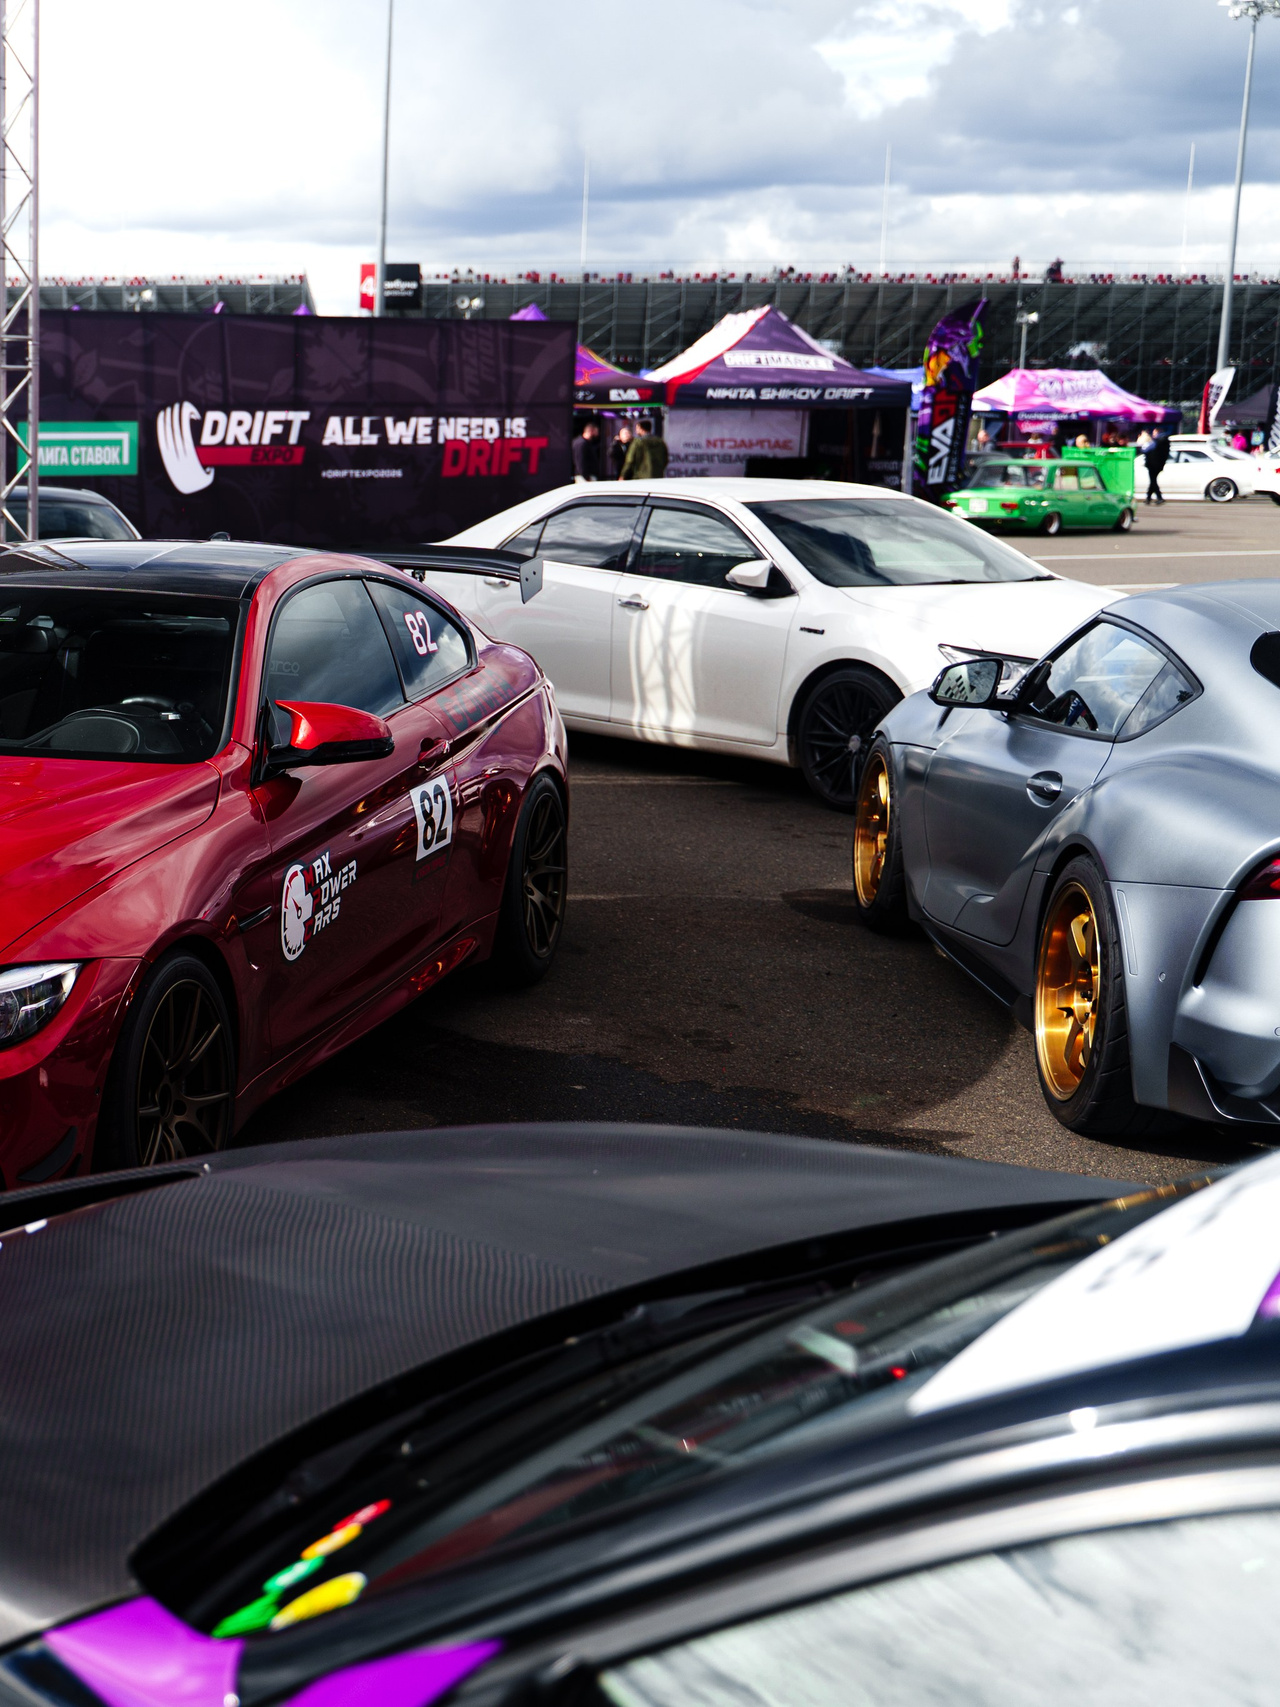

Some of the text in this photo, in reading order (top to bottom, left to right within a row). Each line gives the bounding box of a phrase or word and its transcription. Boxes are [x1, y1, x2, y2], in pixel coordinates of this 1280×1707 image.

[706, 387, 874, 400] NIKITA SHIKOV DRIFT
[200, 411, 310, 445] DRIFT
[322, 416, 528, 446] ALL WE NEED IS
[71, 446, 121, 466] СТАВОК
[250, 446, 295, 463] EXPO
[441, 437, 549, 477] DRIFT
[404, 611, 438, 656] 82
[420, 784, 449, 850] 82
[303, 851, 332, 892] MAX
[312, 860, 357, 913] POWER
[303, 896, 341, 942] CARS
